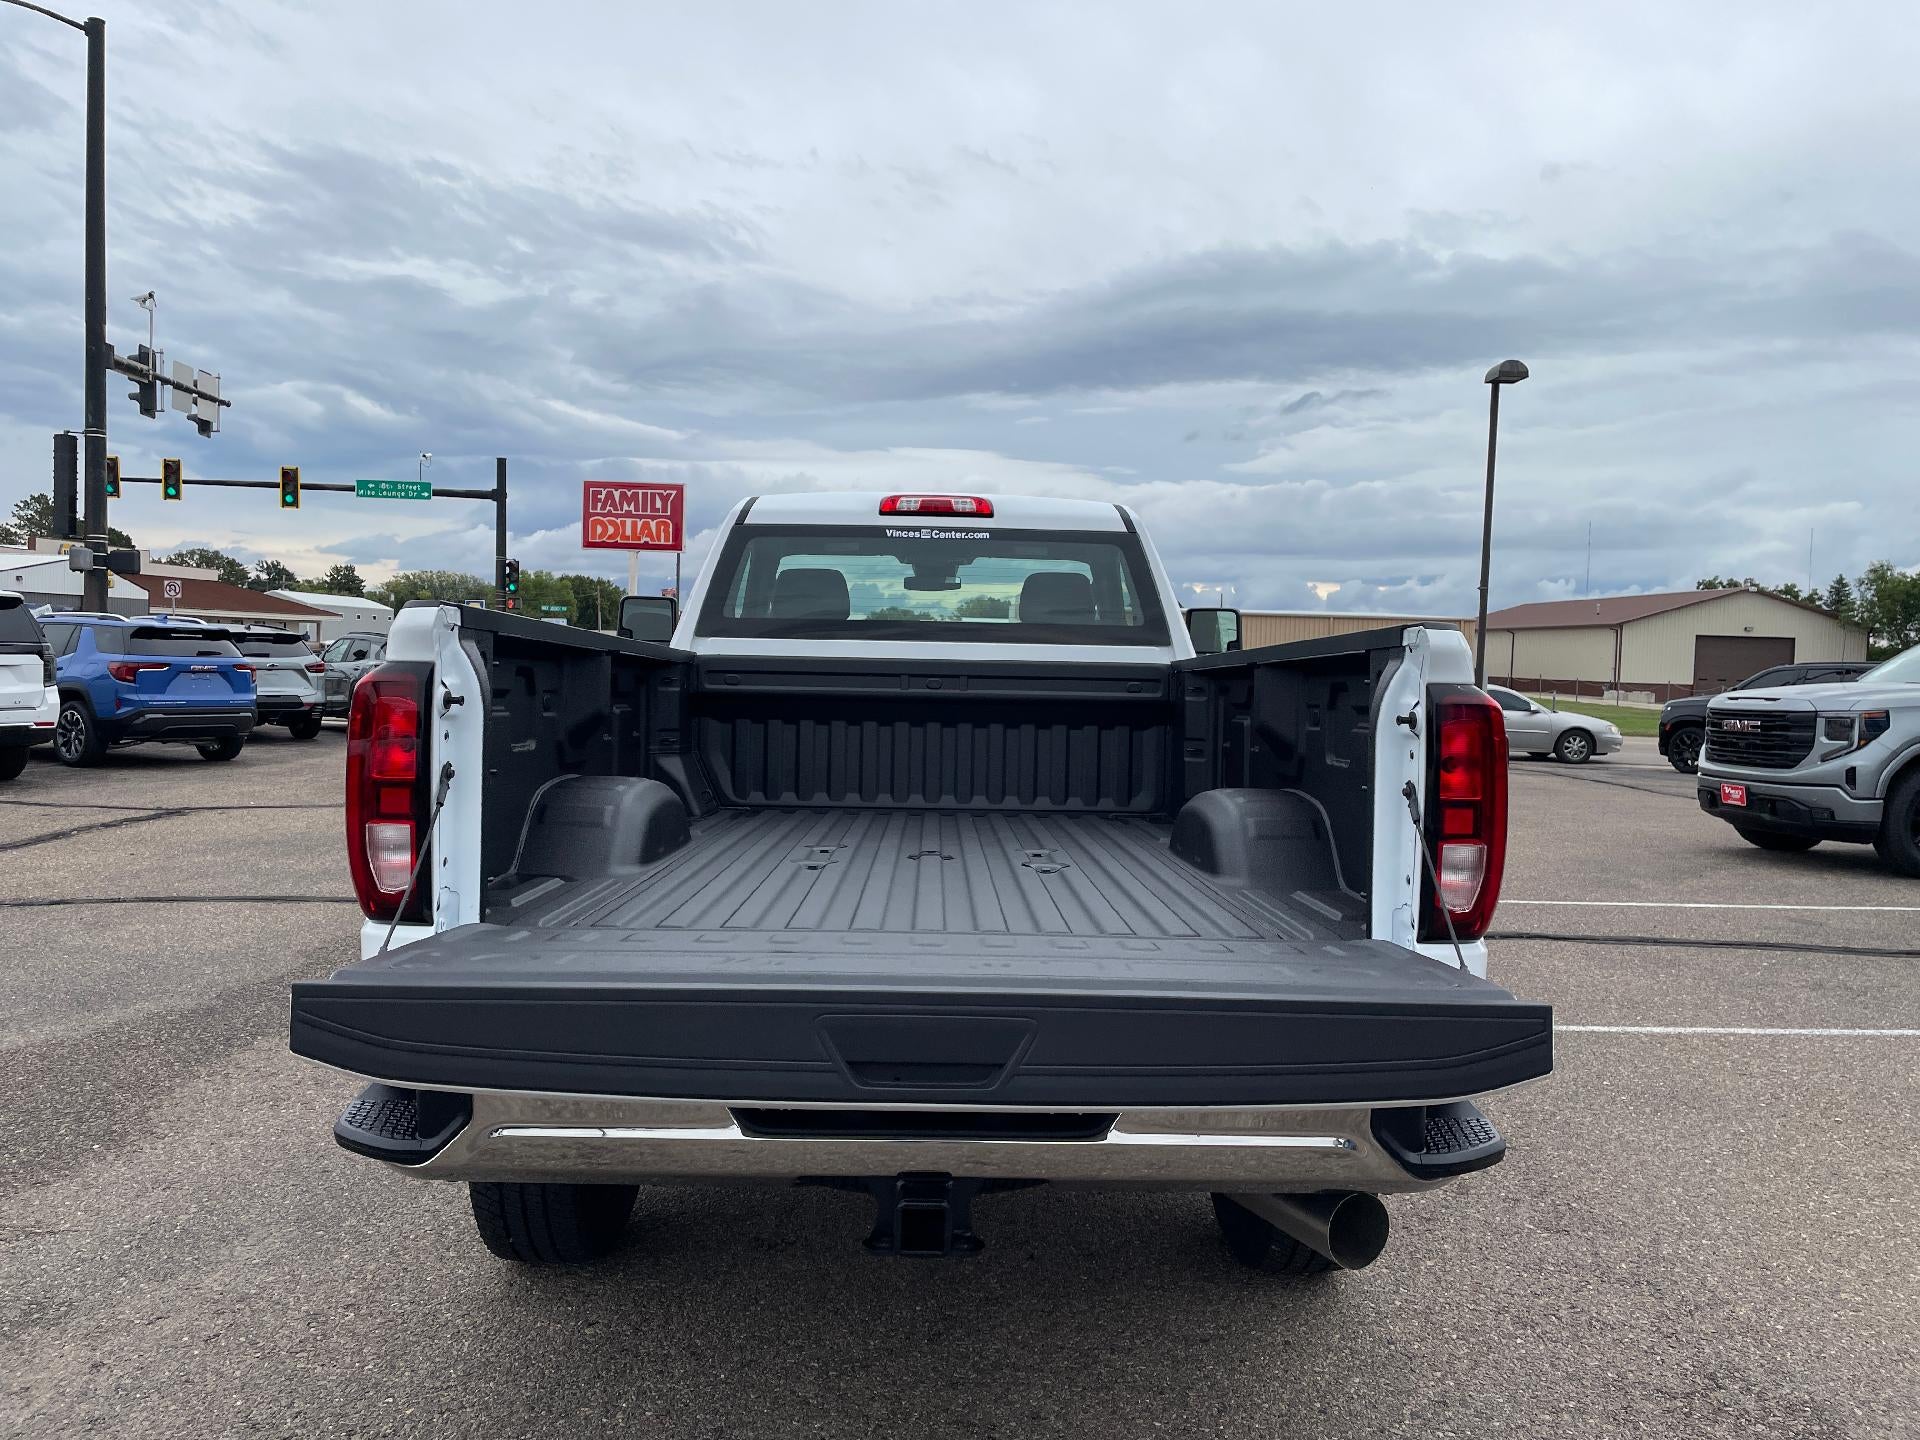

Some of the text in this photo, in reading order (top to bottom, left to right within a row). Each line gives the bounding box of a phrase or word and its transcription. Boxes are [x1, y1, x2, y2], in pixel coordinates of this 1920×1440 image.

[590, 488, 677, 515] FAMILY
[589, 516, 672, 544] DOLLAR
[1722, 719, 1761, 733] GMC
